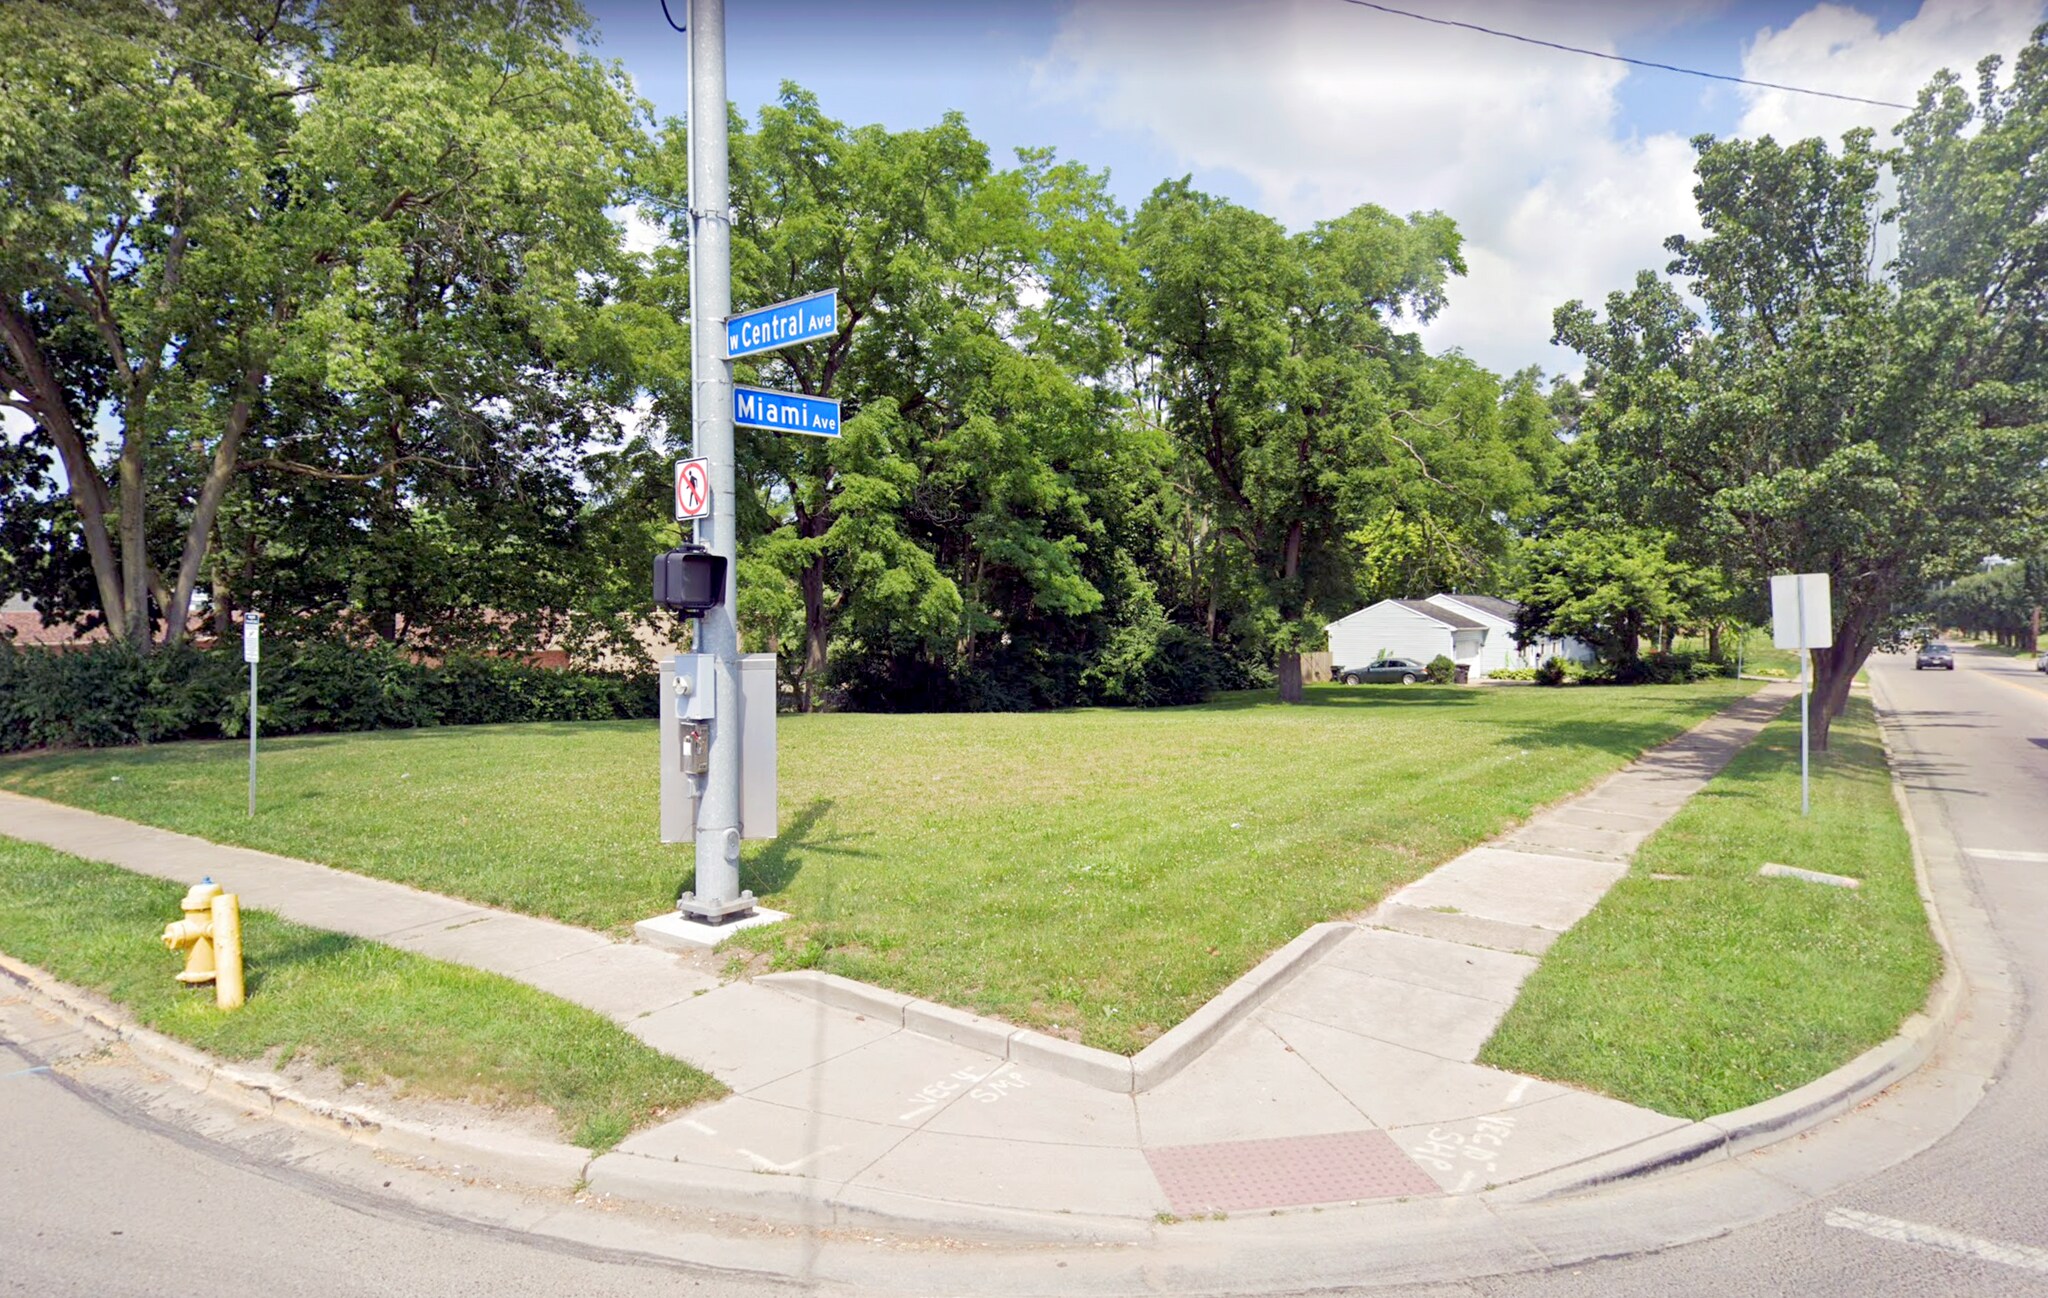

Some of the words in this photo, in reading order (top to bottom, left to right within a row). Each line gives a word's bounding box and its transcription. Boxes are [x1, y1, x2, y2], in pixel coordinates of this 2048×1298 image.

[741, 308, 803, 347] Central
[808, 314, 832, 332] Ave
[737, 394, 808, 427] Miami
[812, 414, 836, 430] Ave
